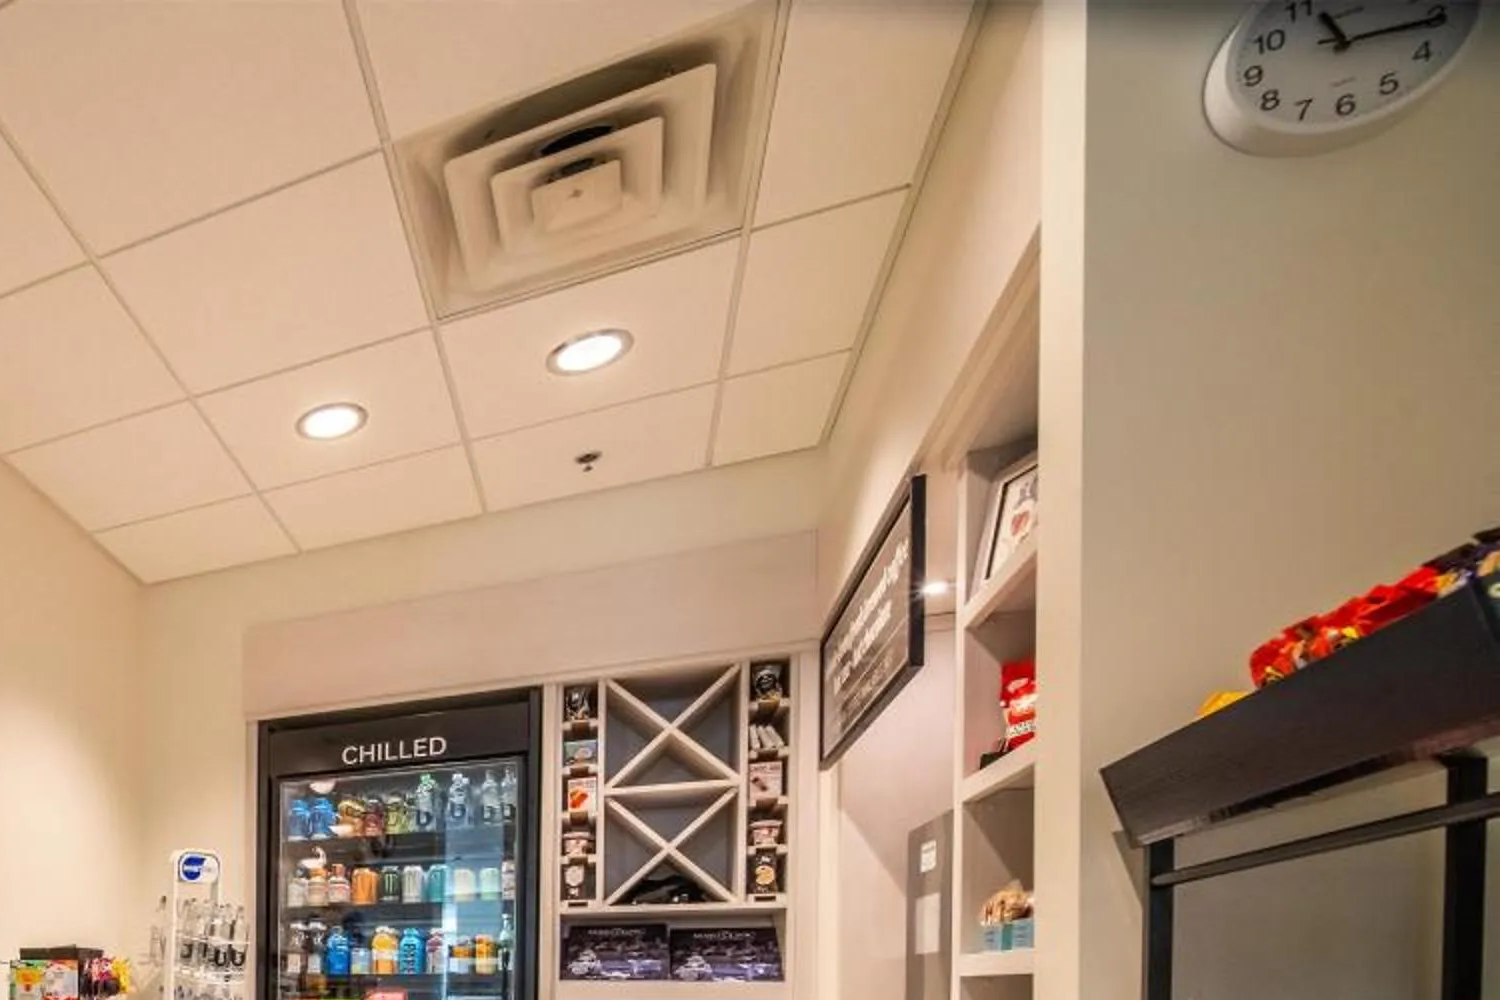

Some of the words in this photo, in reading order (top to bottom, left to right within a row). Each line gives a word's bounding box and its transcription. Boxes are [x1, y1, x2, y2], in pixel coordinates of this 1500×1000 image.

[1254, 29, 1285, 54] 10
[1412, 40, 1431, 62] 4
[1243, 65, 1263, 87] 9
[1380, 72, 1398, 95] 5
[1260, 89, 1280, 111] 8
[1295, 98, 1313, 121] 7
[1335, 94, 1356, 116] 6
[342, 736, 447, 765] CHILLED
